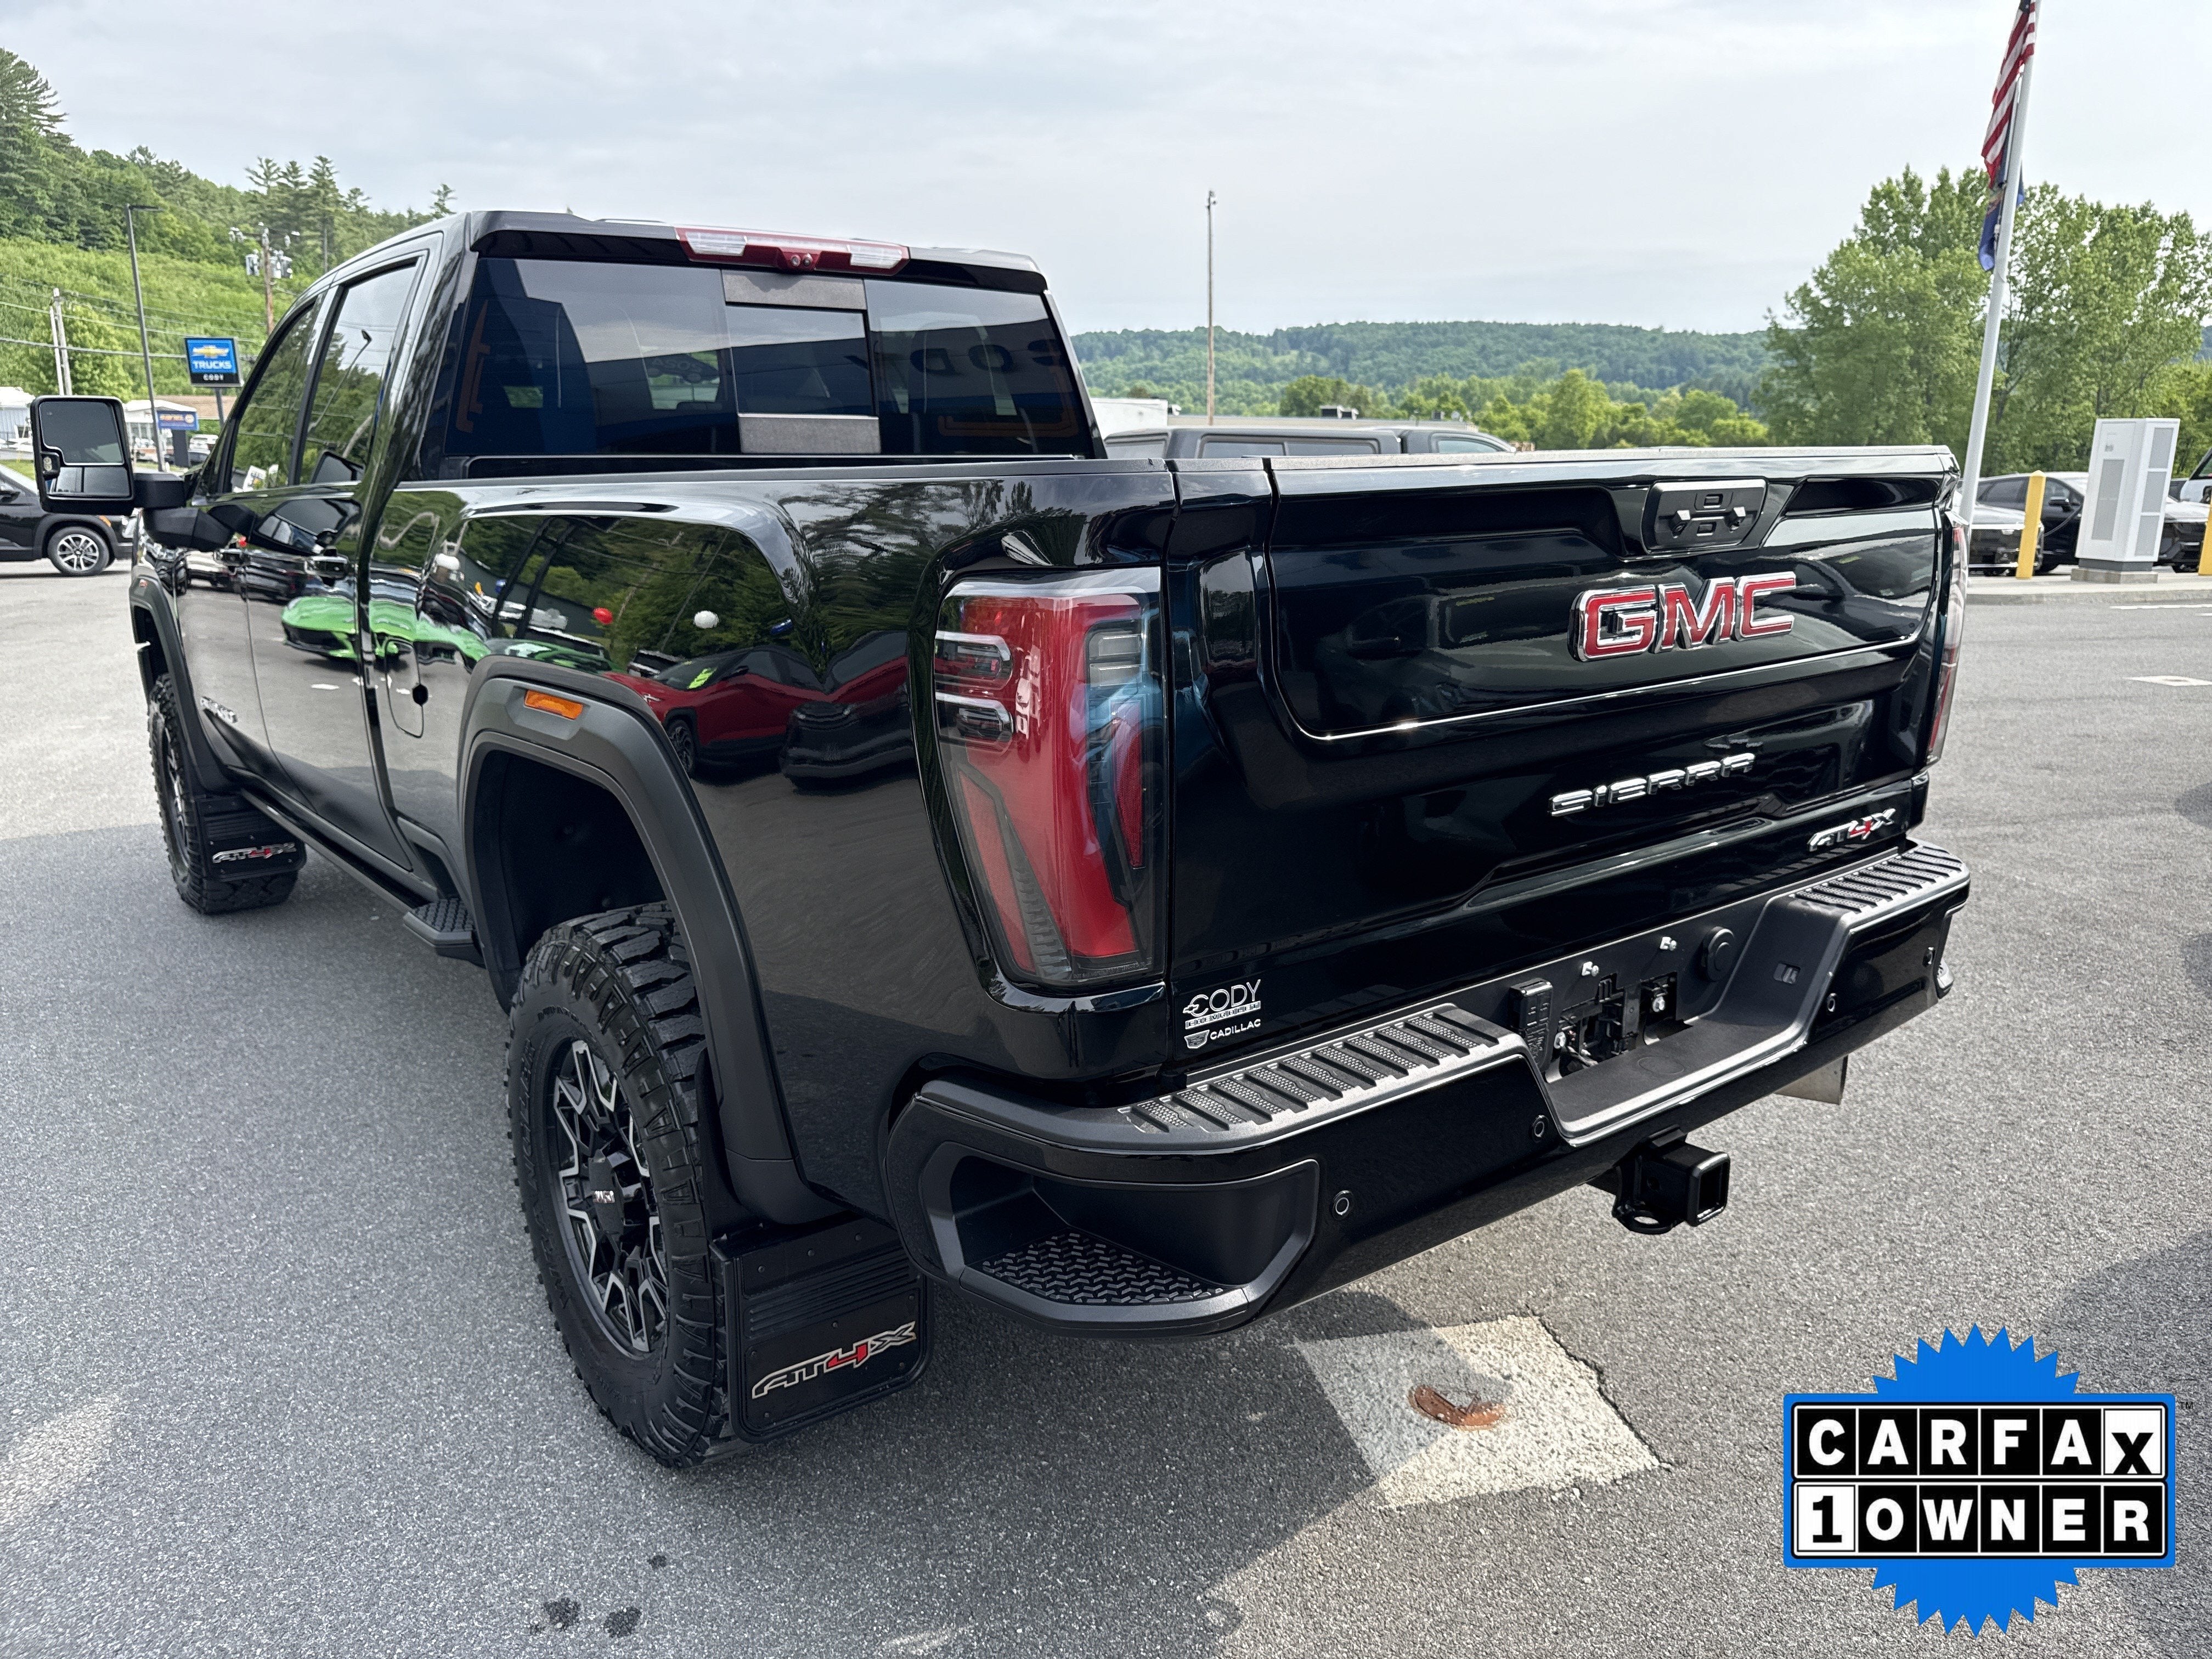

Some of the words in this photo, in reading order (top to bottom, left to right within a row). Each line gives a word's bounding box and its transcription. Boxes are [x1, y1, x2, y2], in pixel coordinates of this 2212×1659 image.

[192, 360, 232, 369] TRUCKS
[1567, 571, 1797, 662] GMC
[1548, 752, 1755, 817] SIERRA
[1807, 808, 1896, 852] AT4X
[212, 842, 296, 864] AT4X
[1183, 979, 1261, 1017] CODY
[1186, 1001, 1260, 1029] CHEVROLET
[1210, 1019, 1261, 1040] CADILLAC
[752, 1321, 917, 1399] AT4X
